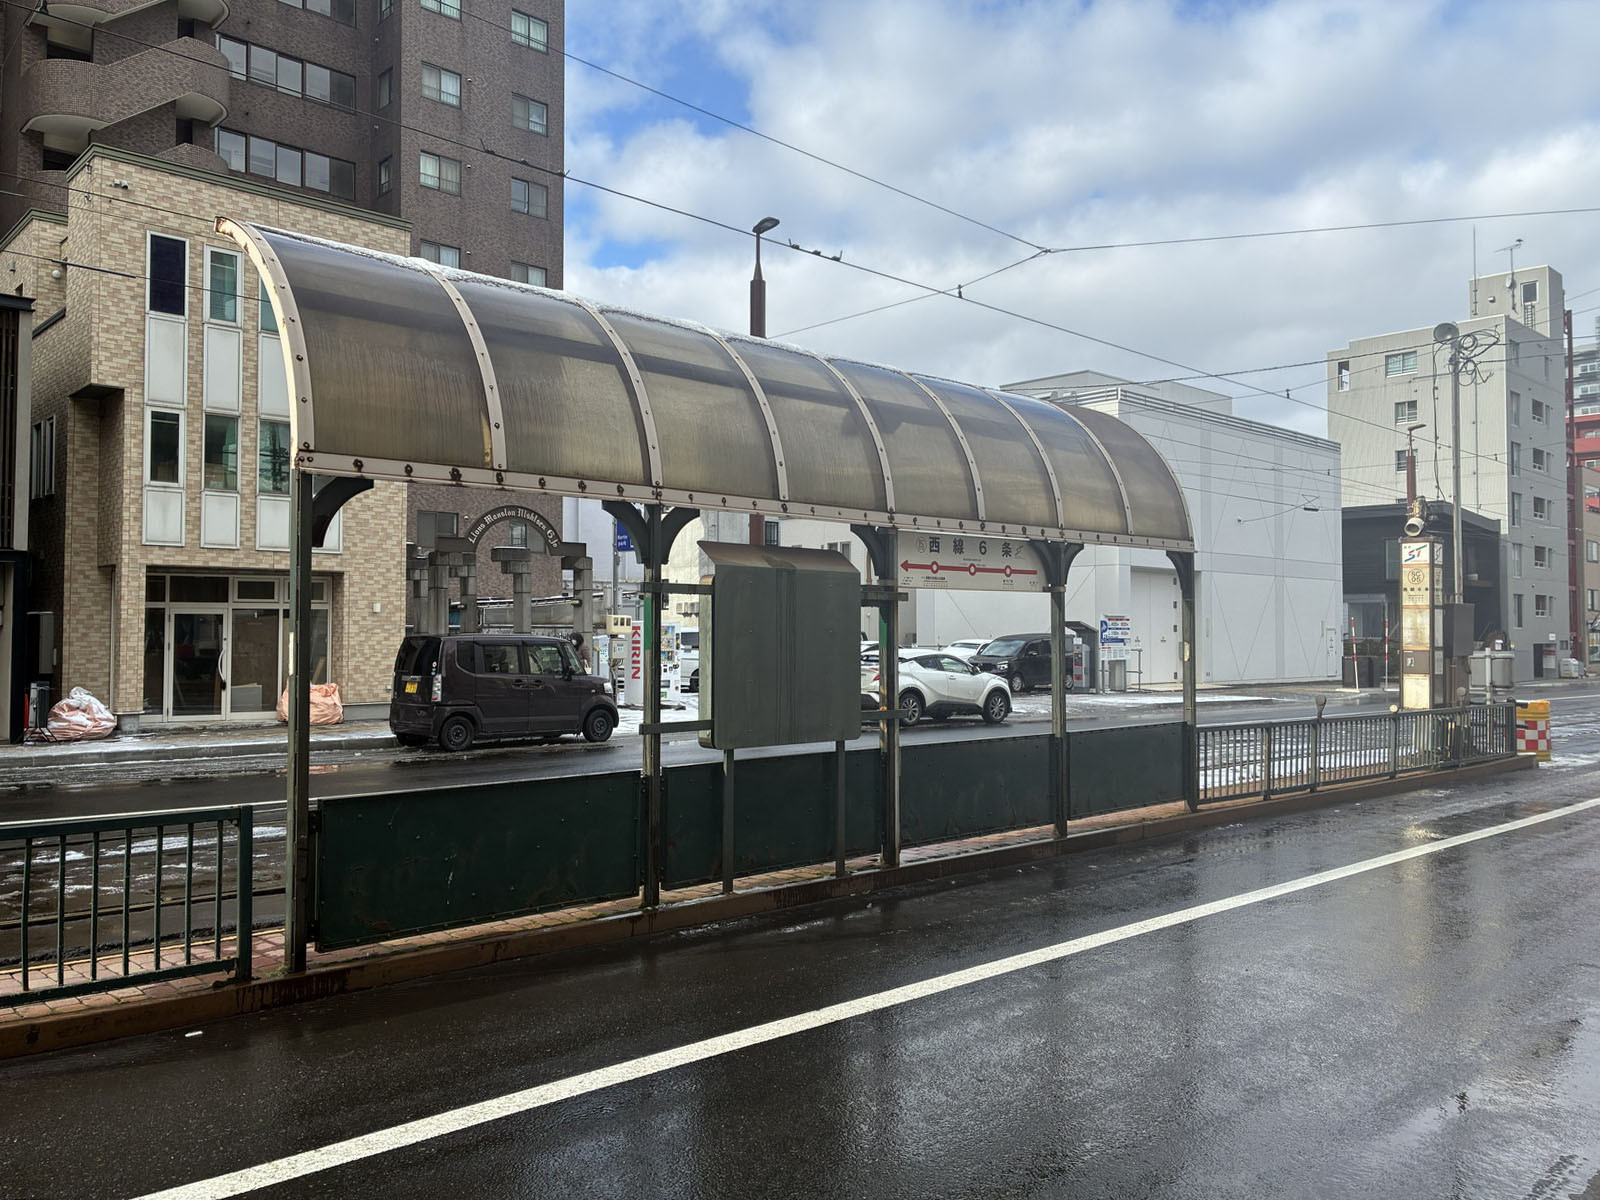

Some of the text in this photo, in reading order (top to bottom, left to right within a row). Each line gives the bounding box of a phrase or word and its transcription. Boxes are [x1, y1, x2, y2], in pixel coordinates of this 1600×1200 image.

[468, 523, 486, 544] Lions
[483, 508, 516, 525] Mansion
[929, 536, 1012, 558] 西線6条
[631, 625, 641, 680] KIRIN
